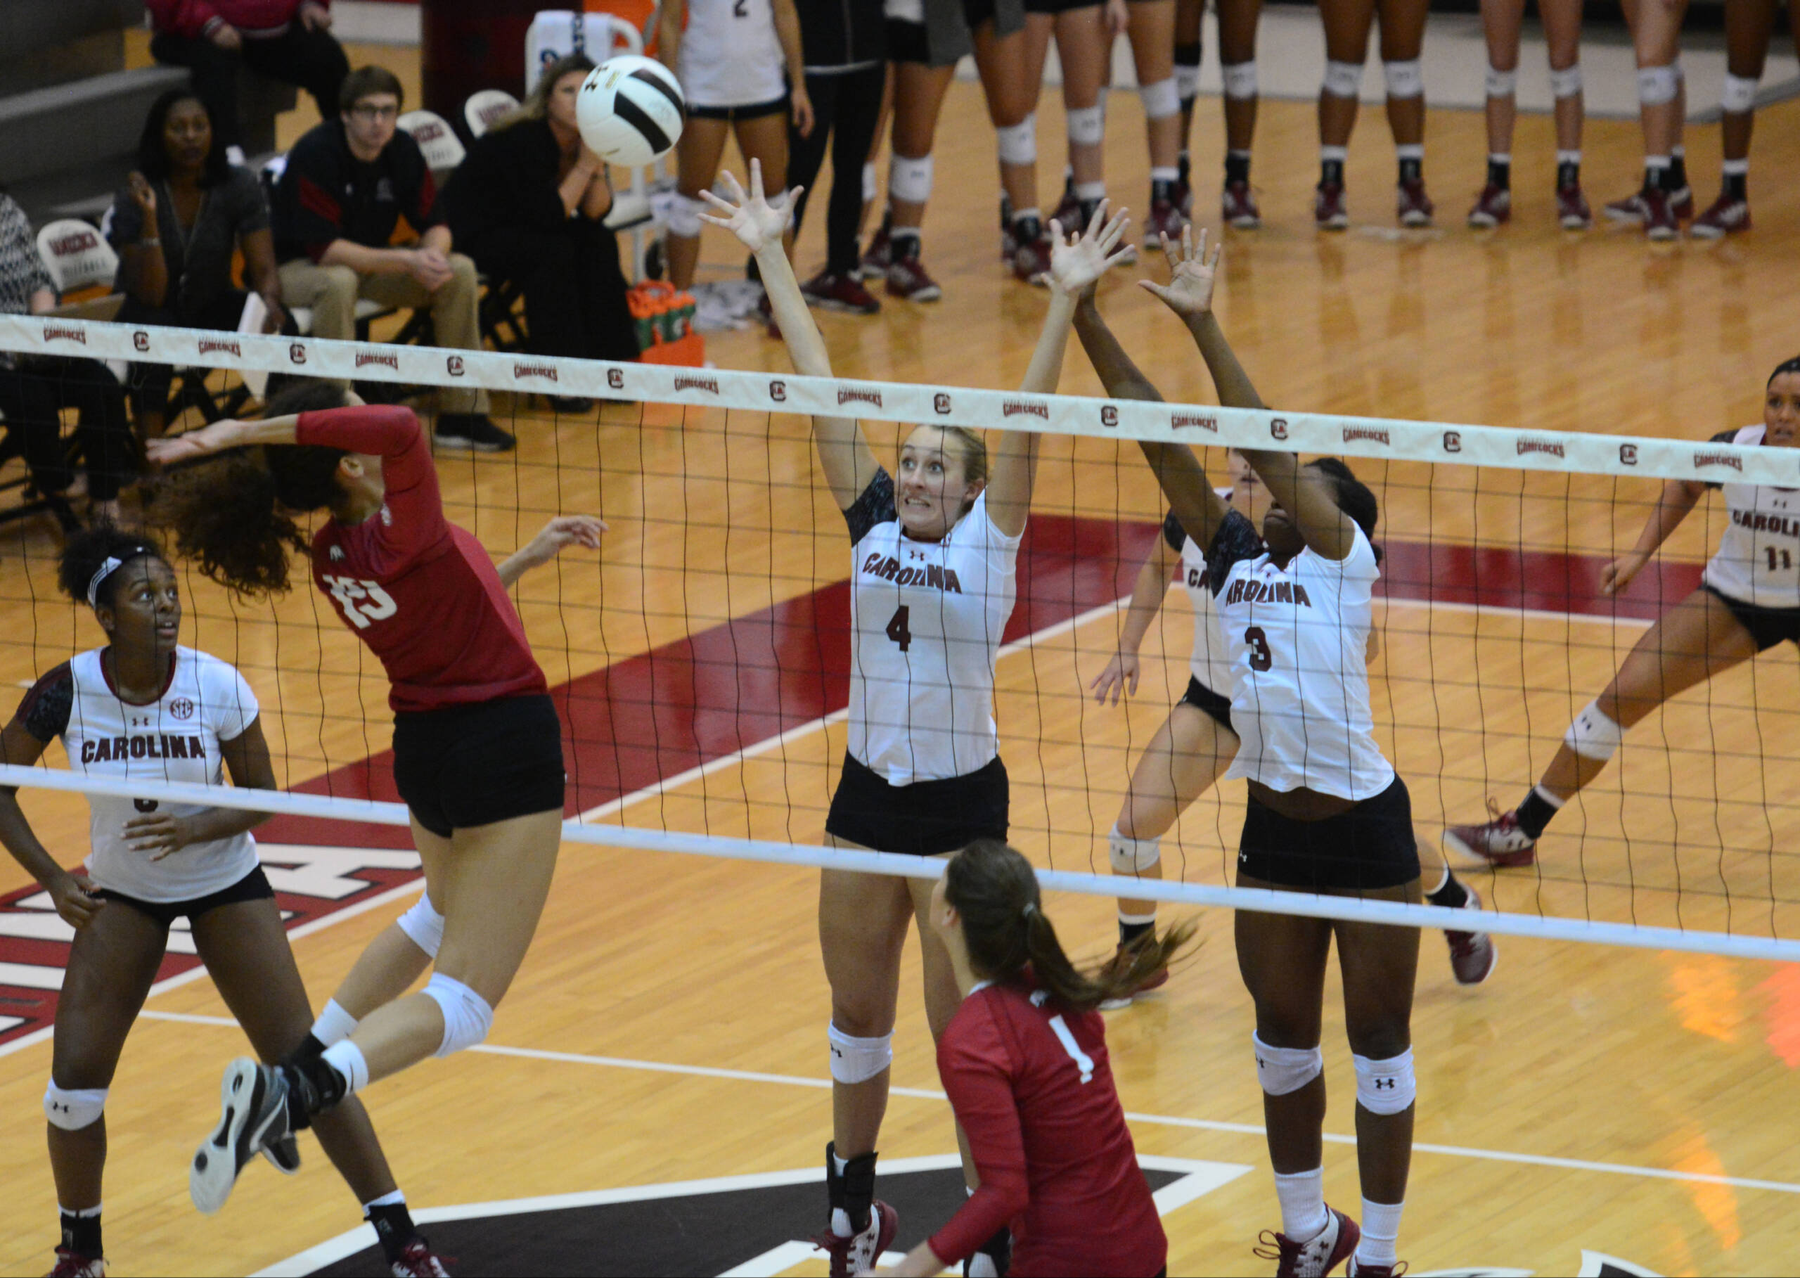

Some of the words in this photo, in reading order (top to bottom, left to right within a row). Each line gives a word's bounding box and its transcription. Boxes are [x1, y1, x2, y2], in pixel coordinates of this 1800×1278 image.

[43, 326, 86, 346] GAMECOCKS
[199, 337, 242, 358] GAMECOCKS
[355, 351, 398, 370] GAMECOCKS
[514, 361, 558, 382] GAMECOCKS
[674, 374, 719, 395] GAMECOCKS
[837, 388, 882, 408] GAMECOCKS
[1003, 400, 1049, 421] GAMECOCKS
[1171, 412, 1217, 433] GAMECOCKS
[1343, 426, 1390, 446] GAMECOCKS
[1516, 438, 1565, 459] GAMECOCKS
[1693, 451, 1743, 472] GAMECOCKS
[1733, 509, 1800, 538] CAROLI
[1764, 545, 1791, 571] 11
[862, 552, 962, 594] CAROLINA
[1188, 568, 1210, 589] CA
[1226, 579, 1312, 607] AROLINA
[886, 605, 911, 652] 4
[1245, 627, 1272, 672] 3
[81, 735, 206, 763] CAROLINA
[1048, 1014, 1094, 1085] 1
